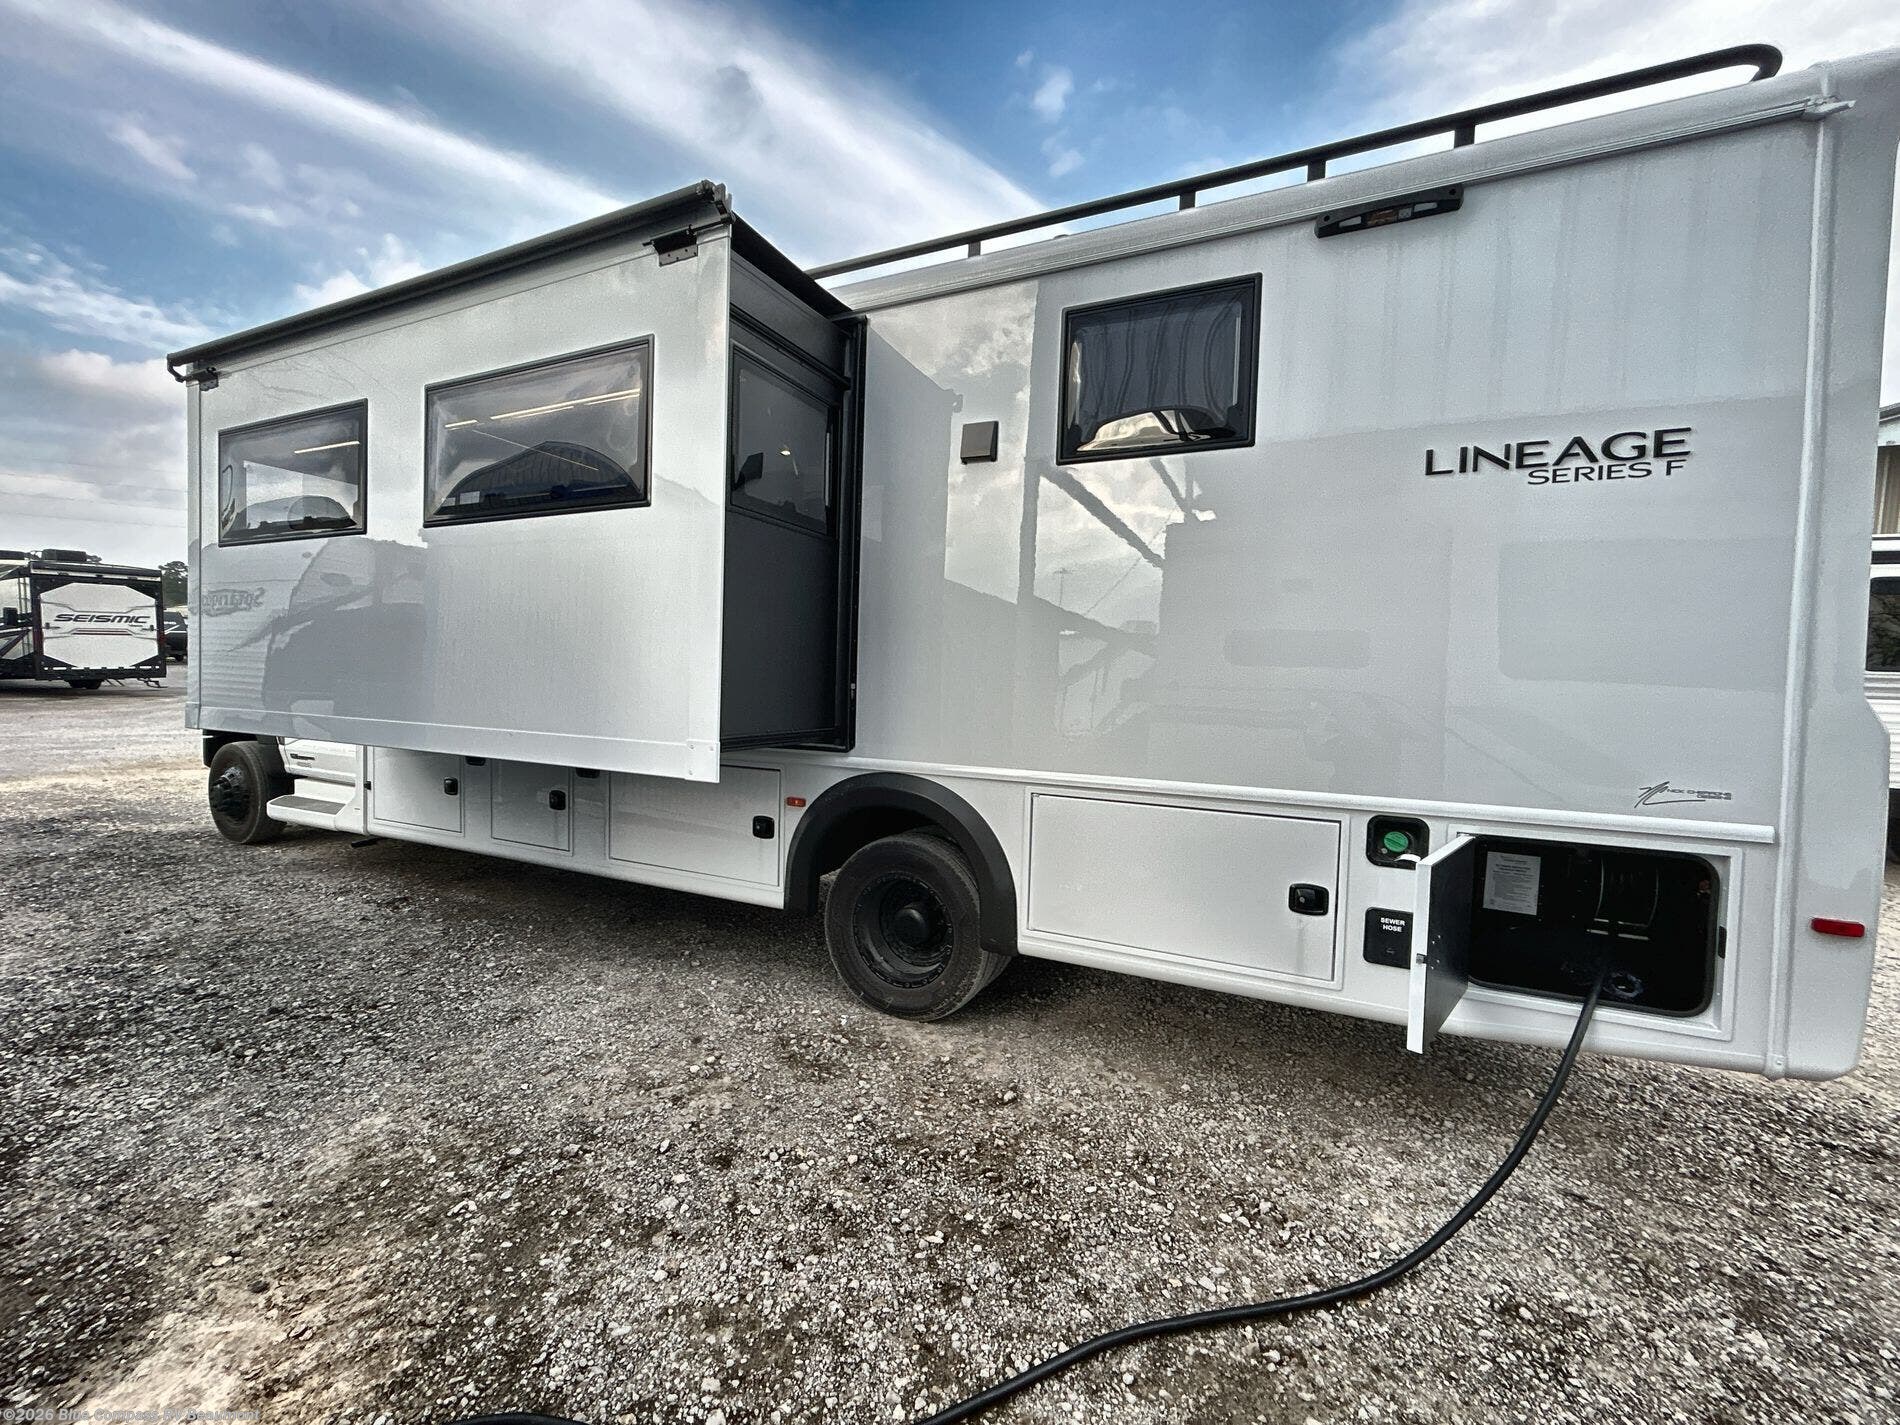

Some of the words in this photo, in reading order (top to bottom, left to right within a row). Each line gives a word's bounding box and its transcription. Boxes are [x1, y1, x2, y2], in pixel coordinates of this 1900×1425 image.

[1425, 427, 1692, 476] LINEAGE
[1527, 461, 1652, 485] SERIES
[1666, 459, 1687, 476] F
[54, 613, 151, 624] SEISMIC
[1380, 917, 1405, 926] SEWER
[1382, 924, 1403, 932] HOSE
